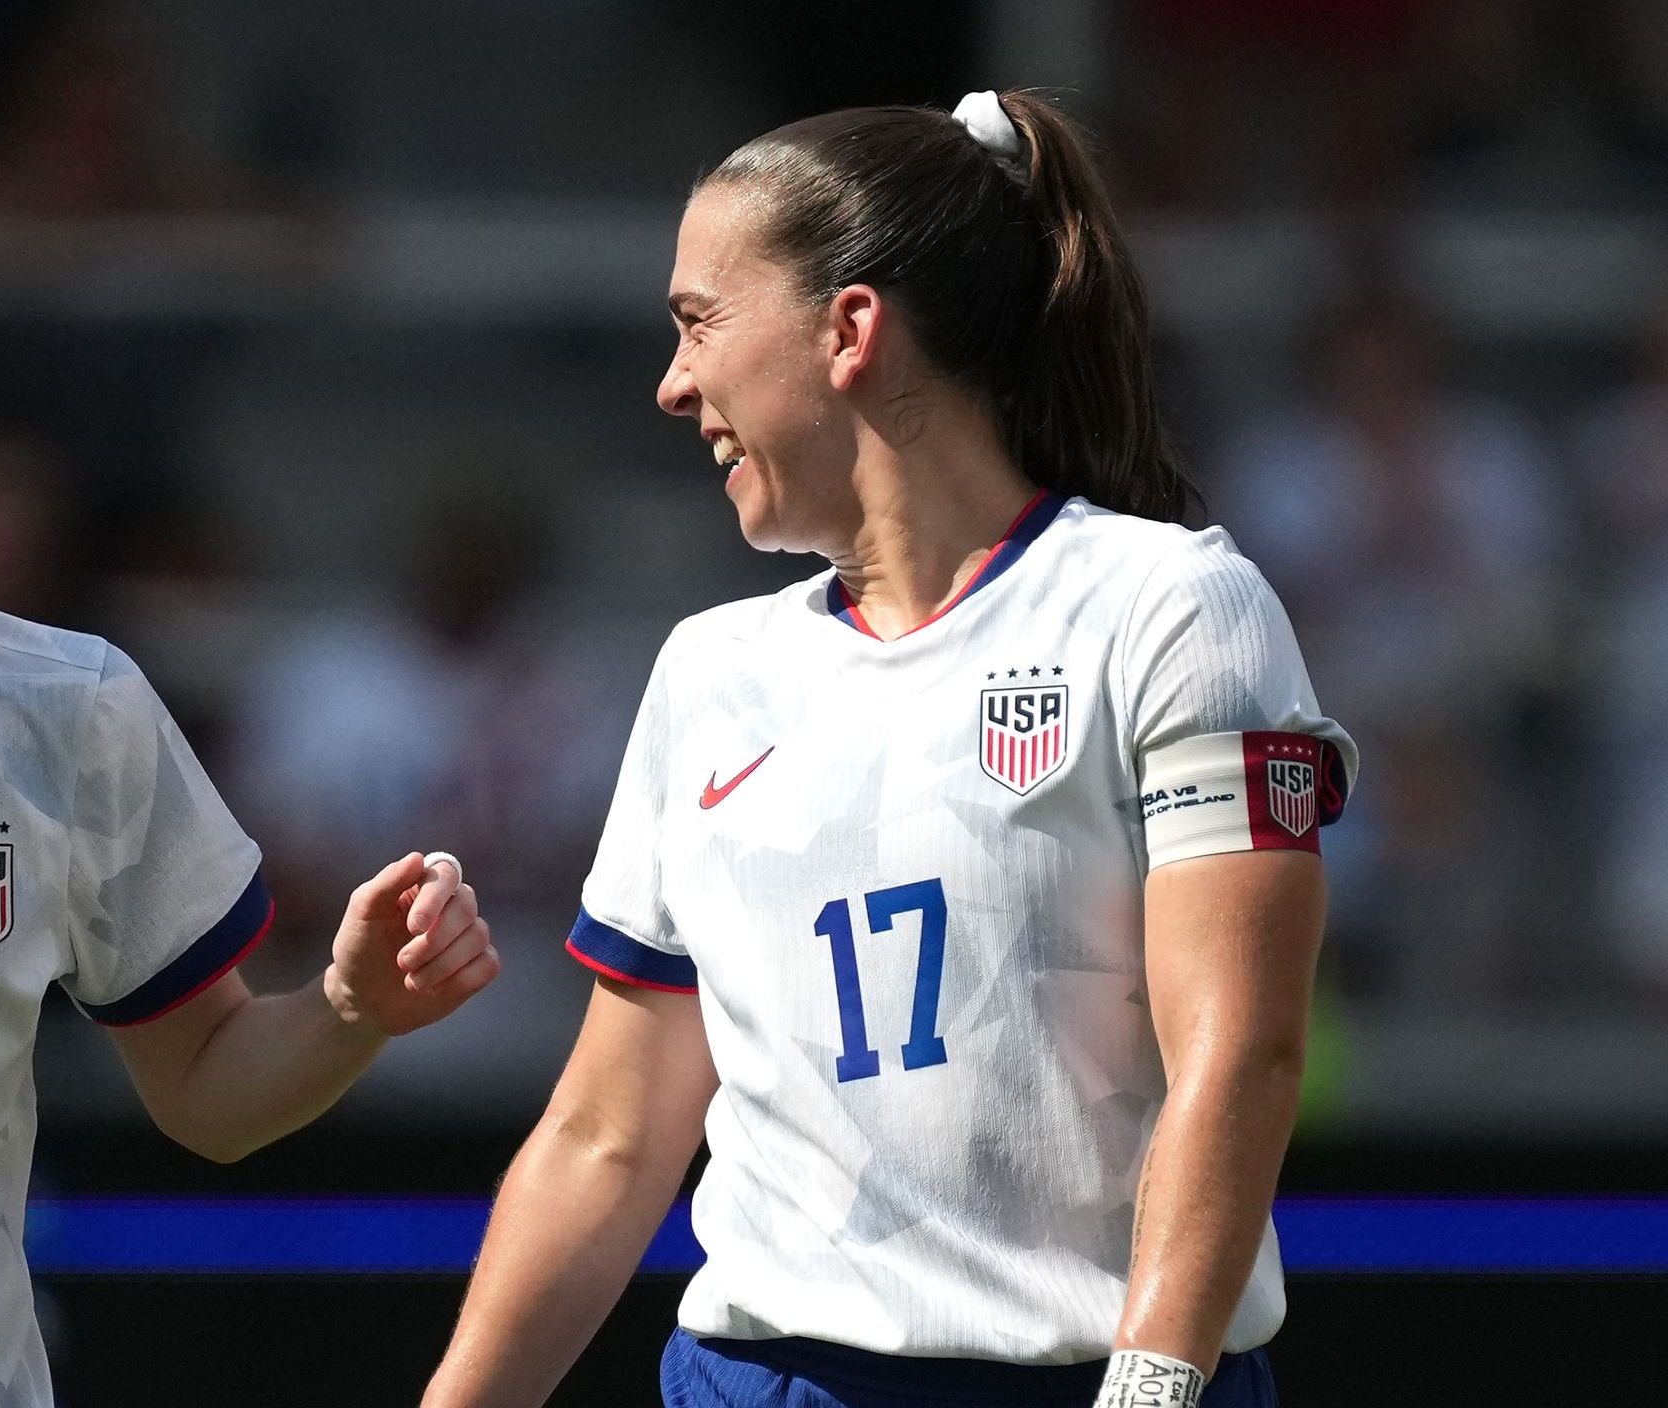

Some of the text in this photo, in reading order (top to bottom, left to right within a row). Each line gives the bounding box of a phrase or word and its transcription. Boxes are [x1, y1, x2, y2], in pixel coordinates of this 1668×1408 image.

[988, 692, 1061, 733] USA
[1173, 785, 1198, 797] VS
[1270, 763, 1313, 793] USA
[1174, 793, 1235, 809] IRELAND
[814, 878, 947, 1083] 17
